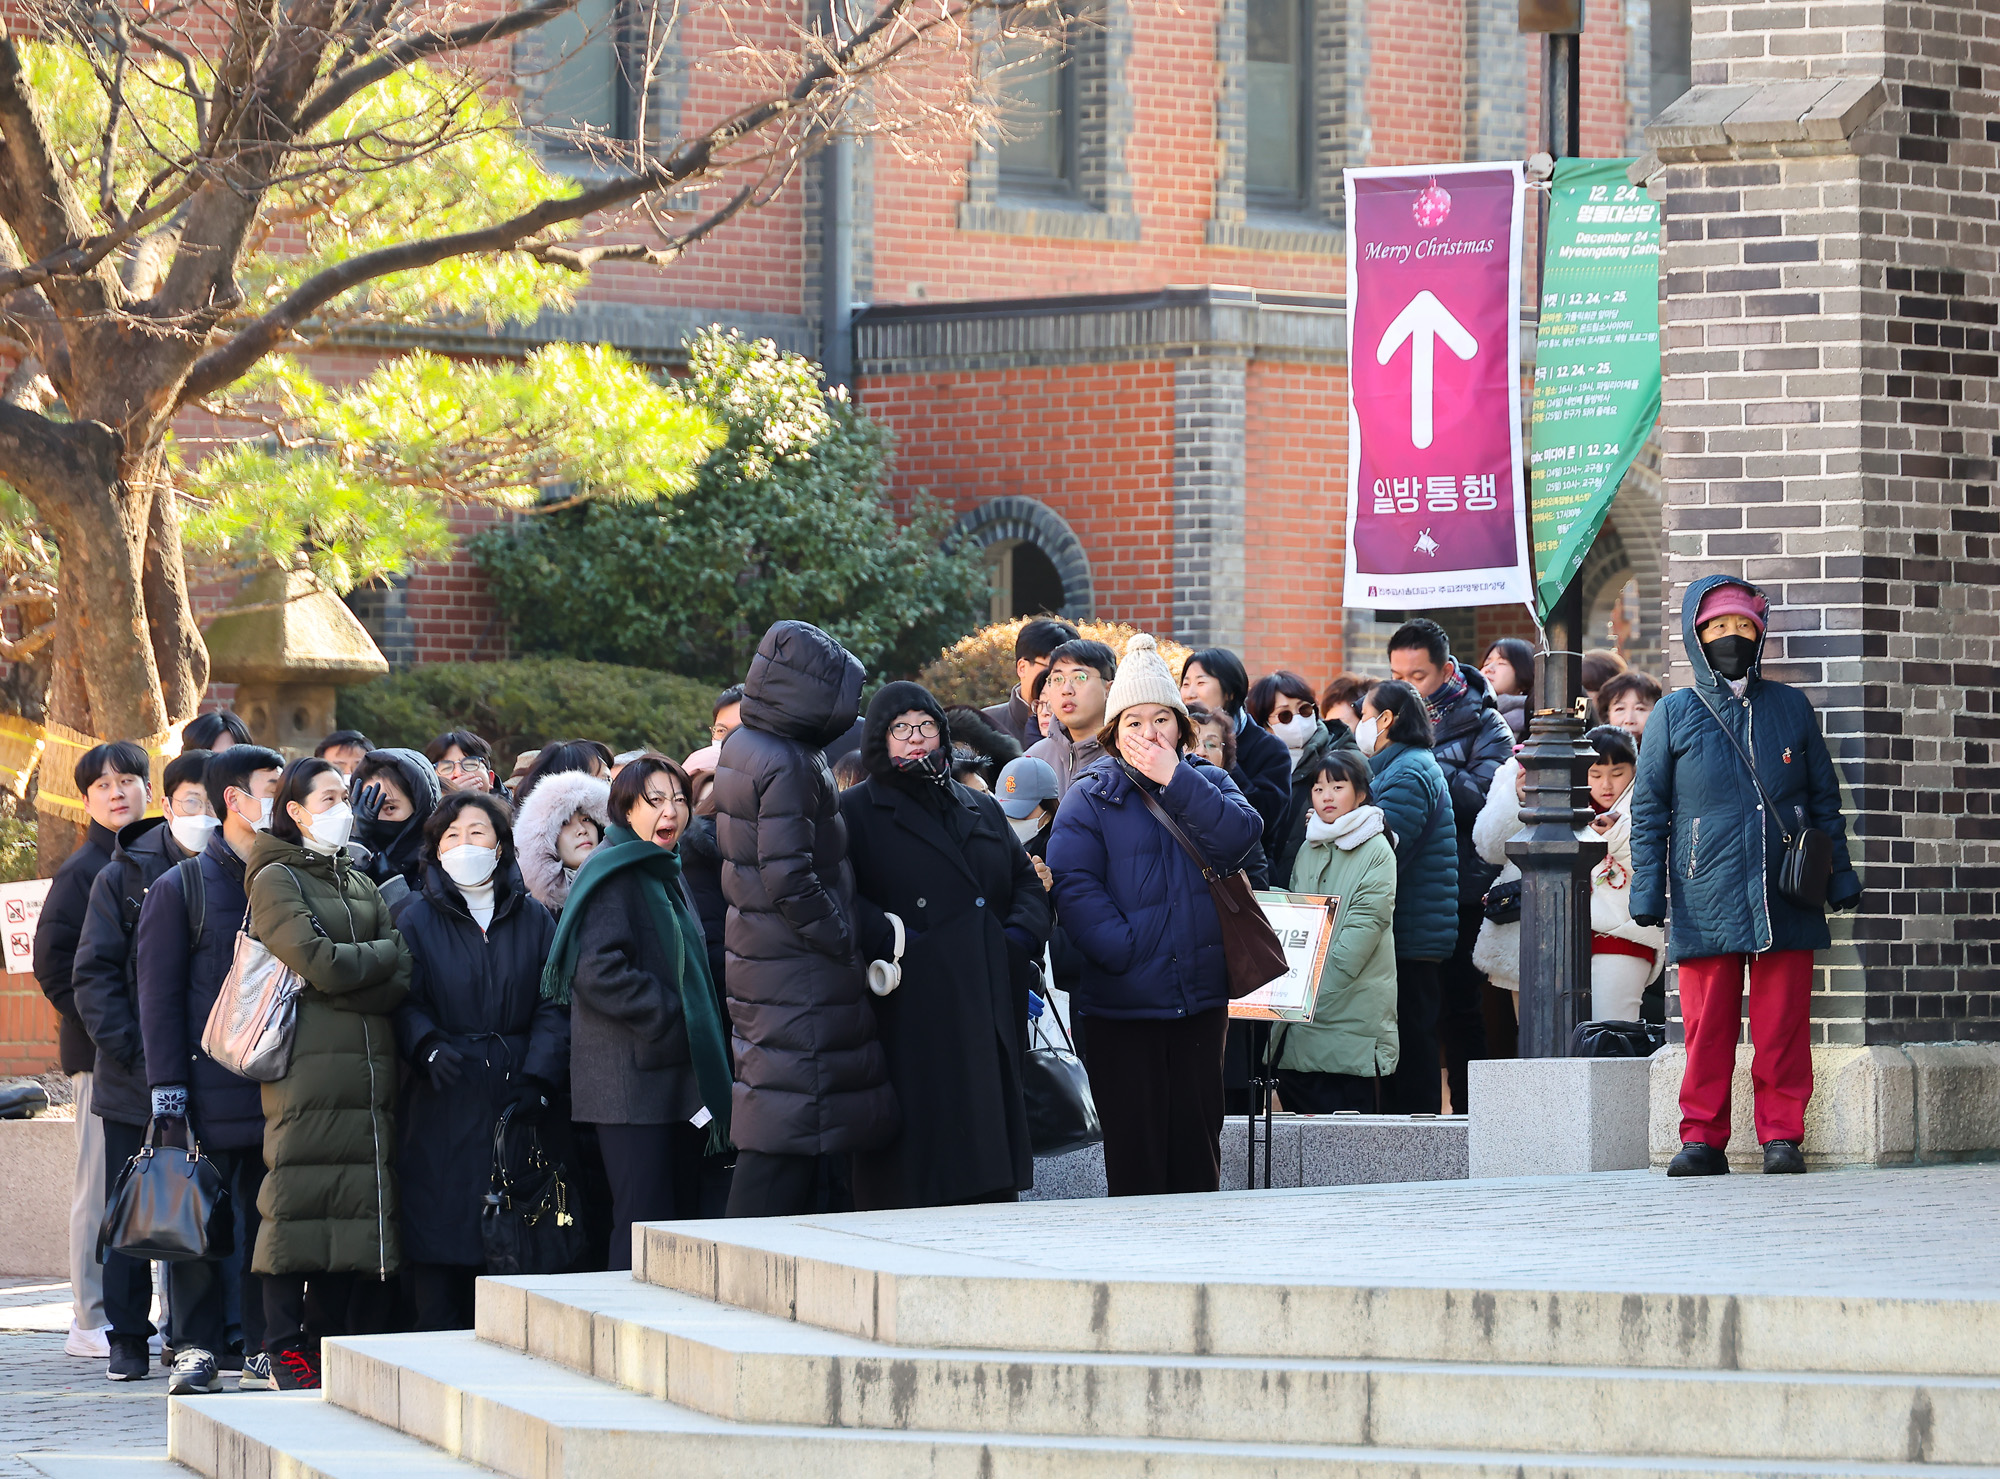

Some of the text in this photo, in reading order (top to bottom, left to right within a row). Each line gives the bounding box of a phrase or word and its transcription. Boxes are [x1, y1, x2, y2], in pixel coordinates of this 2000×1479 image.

[1575, 231, 1633, 244] December
[1633, 230, 1649, 242] 24
[1365, 236, 1495, 264] Merry Christmas
[1559, 244, 1631, 260] Myeongdong
[1373, 473, 1498, 514] 일방통행
